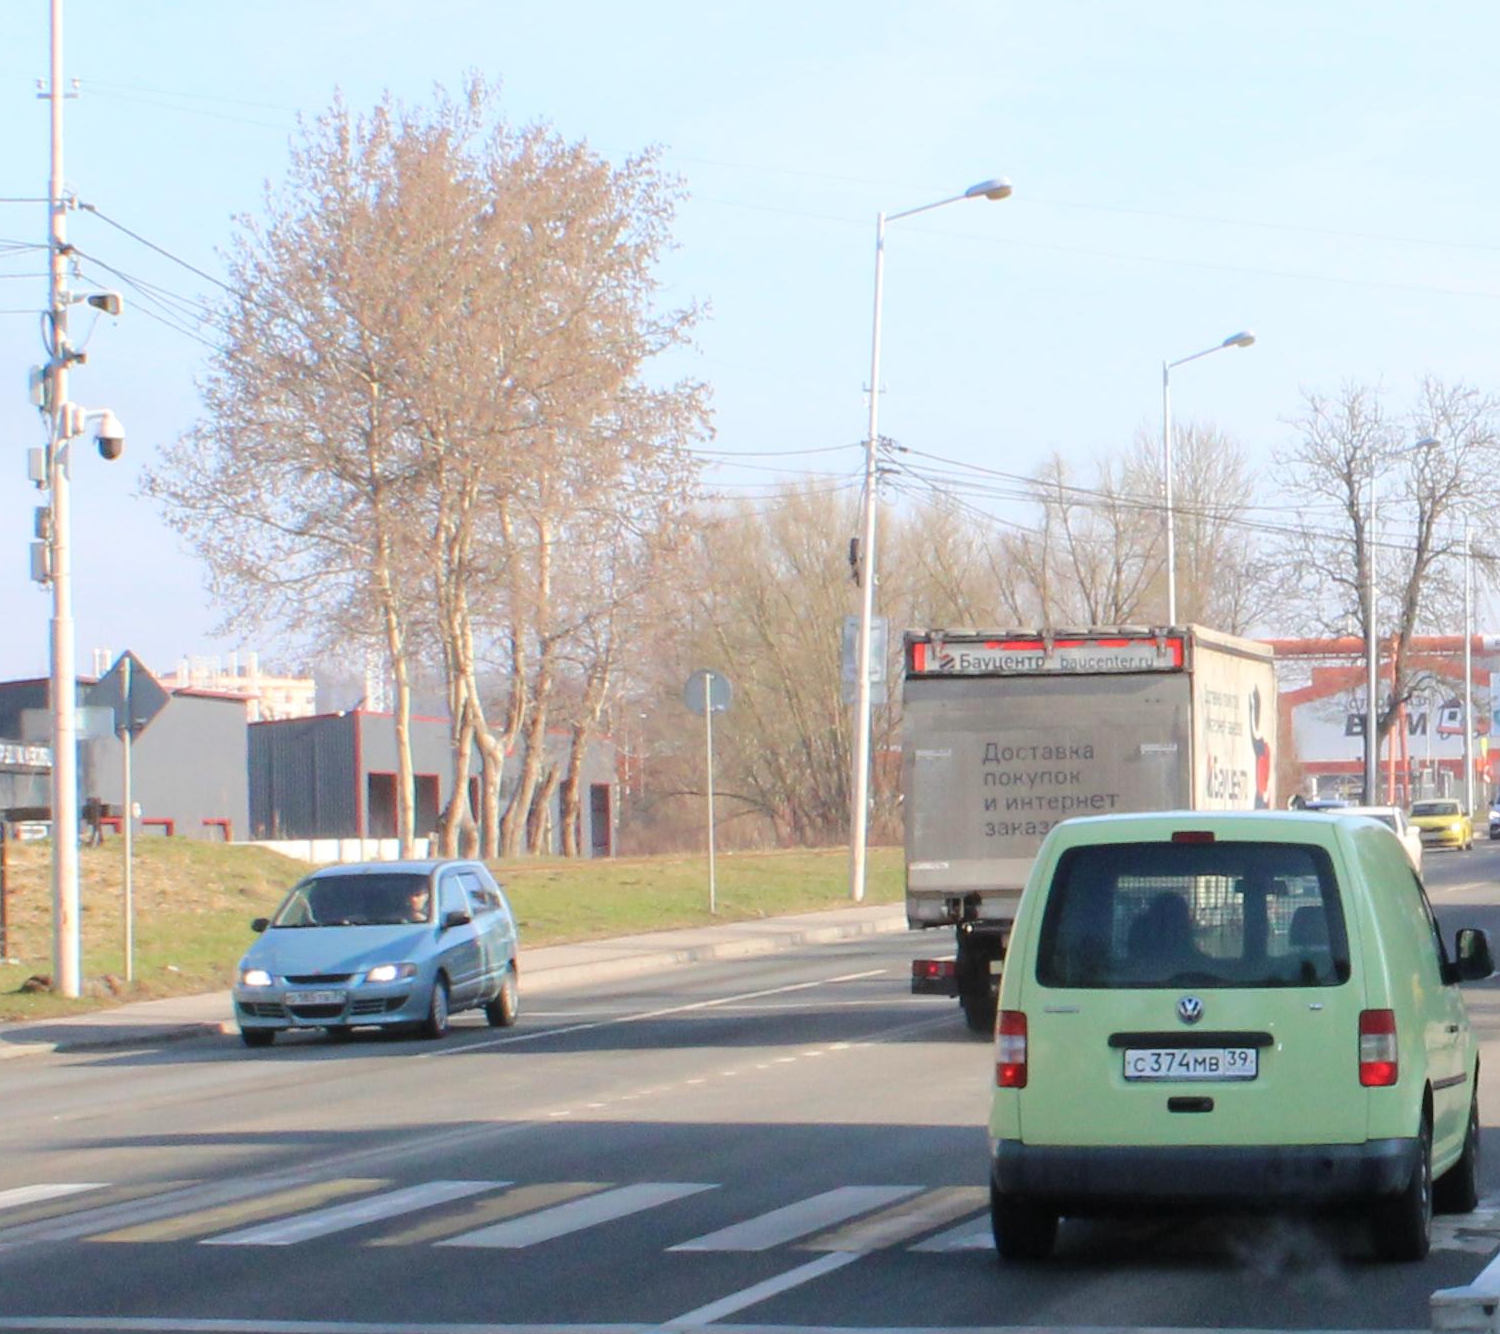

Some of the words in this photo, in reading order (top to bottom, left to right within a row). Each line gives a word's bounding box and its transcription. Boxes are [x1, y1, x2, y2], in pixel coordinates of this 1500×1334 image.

[959, 653, 1047, 673] Бауцентр
[1059, 653, 1155, 669] baucenter.ru
[982, 742, 1095, 765] Доставка
[983, 770, 1081, 790] покупок
[984, 797, 997, 812] и
[1006, 793, 1120, 814] интернет
[984, 819, 1059, 837] заказ
[1226, 1050, 1249, 1068] 39
